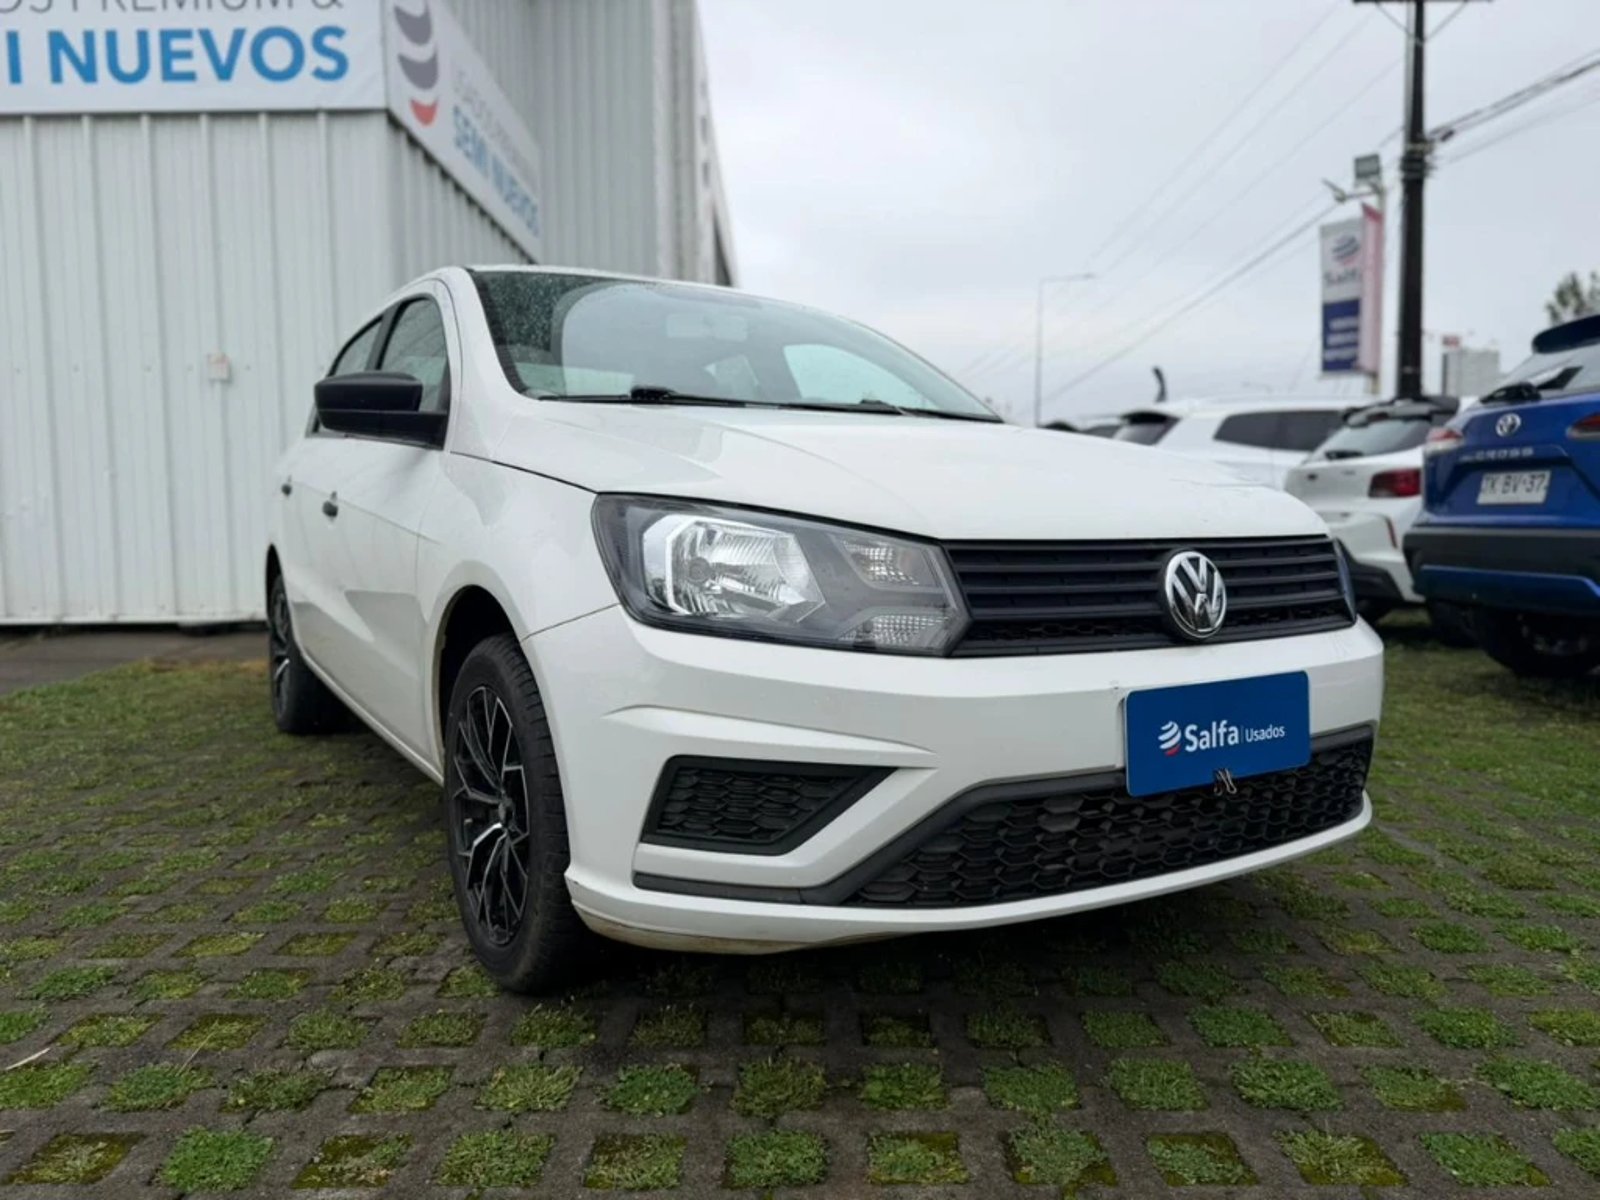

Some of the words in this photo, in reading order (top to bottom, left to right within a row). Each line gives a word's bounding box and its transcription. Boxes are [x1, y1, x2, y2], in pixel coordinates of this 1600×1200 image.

[47, 26, 349, 84] NUEVOS
[1184, 720, 1239, 752] Salfa
[1245, 724, 1285, 742] Usados
